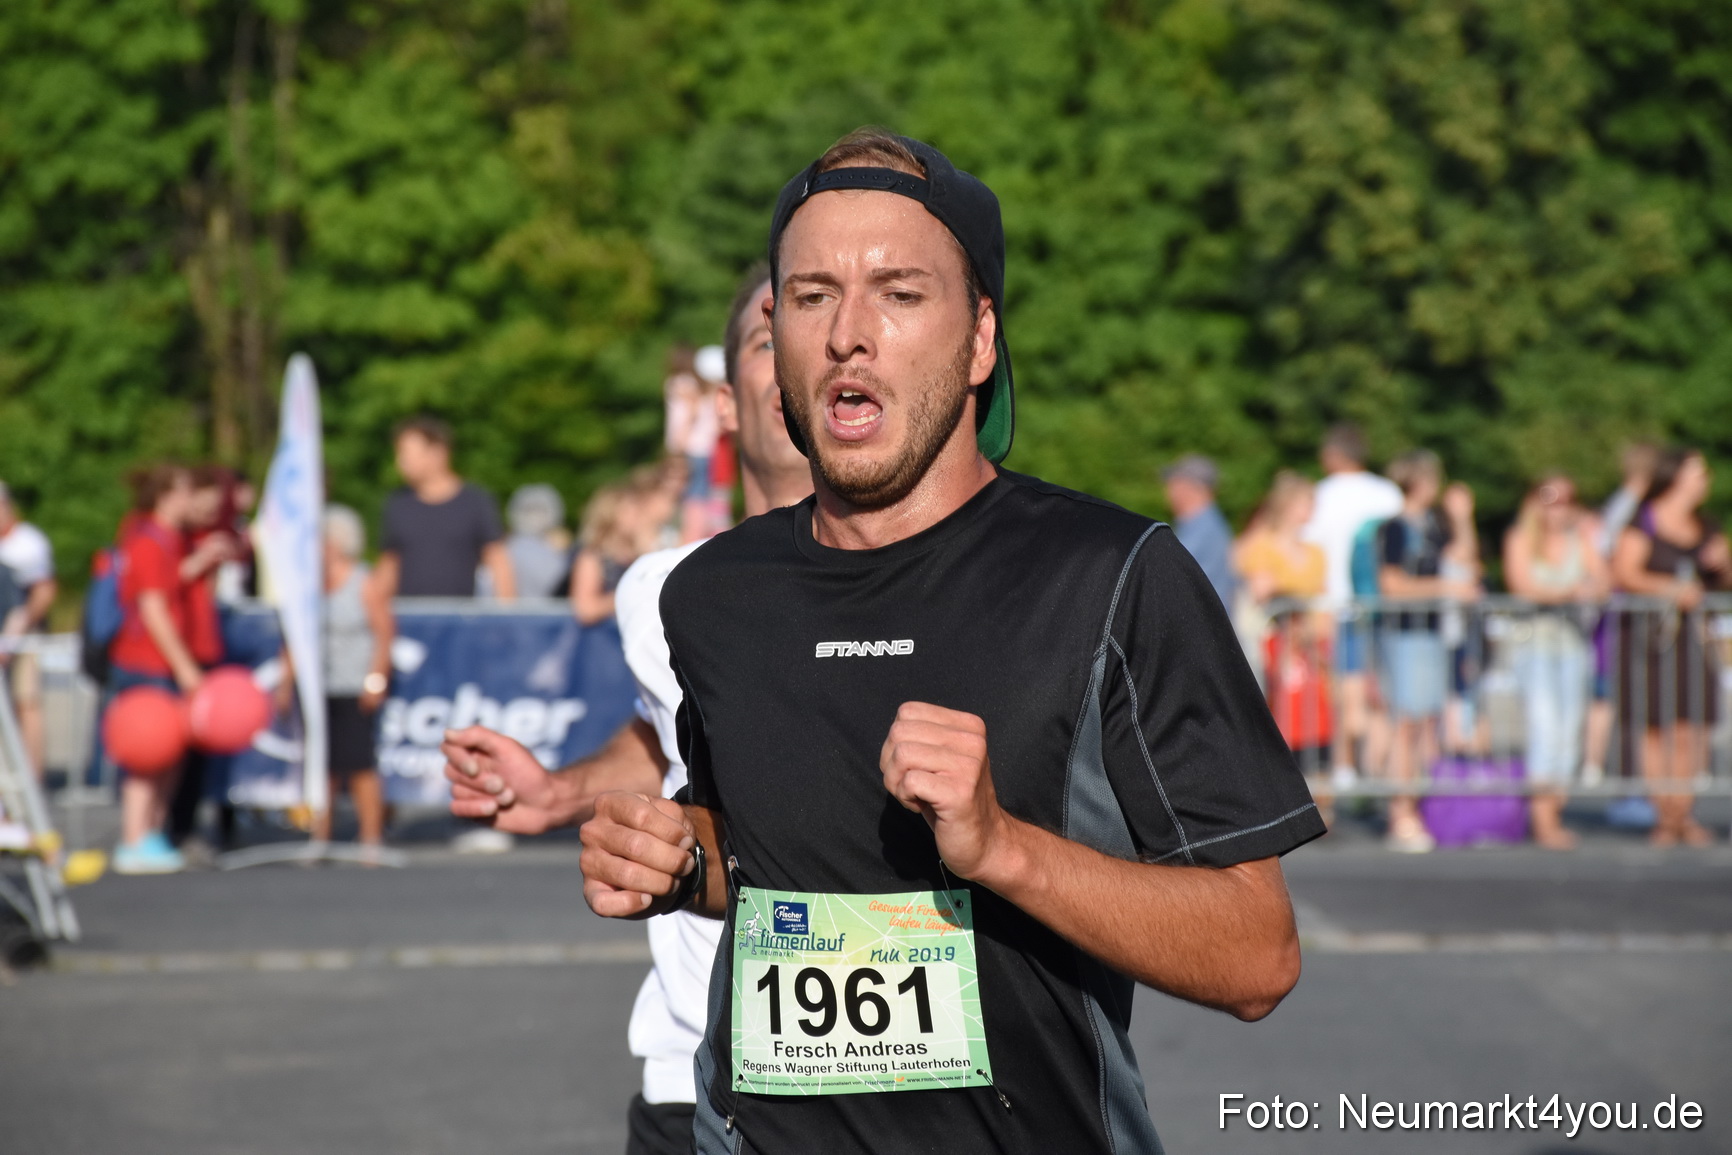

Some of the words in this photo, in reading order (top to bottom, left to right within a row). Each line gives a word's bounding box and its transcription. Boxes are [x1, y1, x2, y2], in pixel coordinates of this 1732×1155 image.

[815, 639, 914, 658] STANNO
[779, 910, 803, 919] Fischer
[868, 900, 914, 915] Gesunde
[916, 904, 953, 918] Firmen
[889, 915, 922, 930] laufen
[761, 928, 846, 951] firmenlauf
[760, 949, 794, 958] neumarkt
[908, 946, 955, 963] 2019
[757, 964, 934, 1037] 1961
[773, 1041, 838, 1058] Fersch
[844, 1040, 928, 1058] Andreas
[743, 1059, 782, 1074] Regens
[784, 1062, 833, 1076] Wagner
[836, 1062, 888, 1073] Stiftung
[891, 1057, 972, 1071] Lauterhofen
